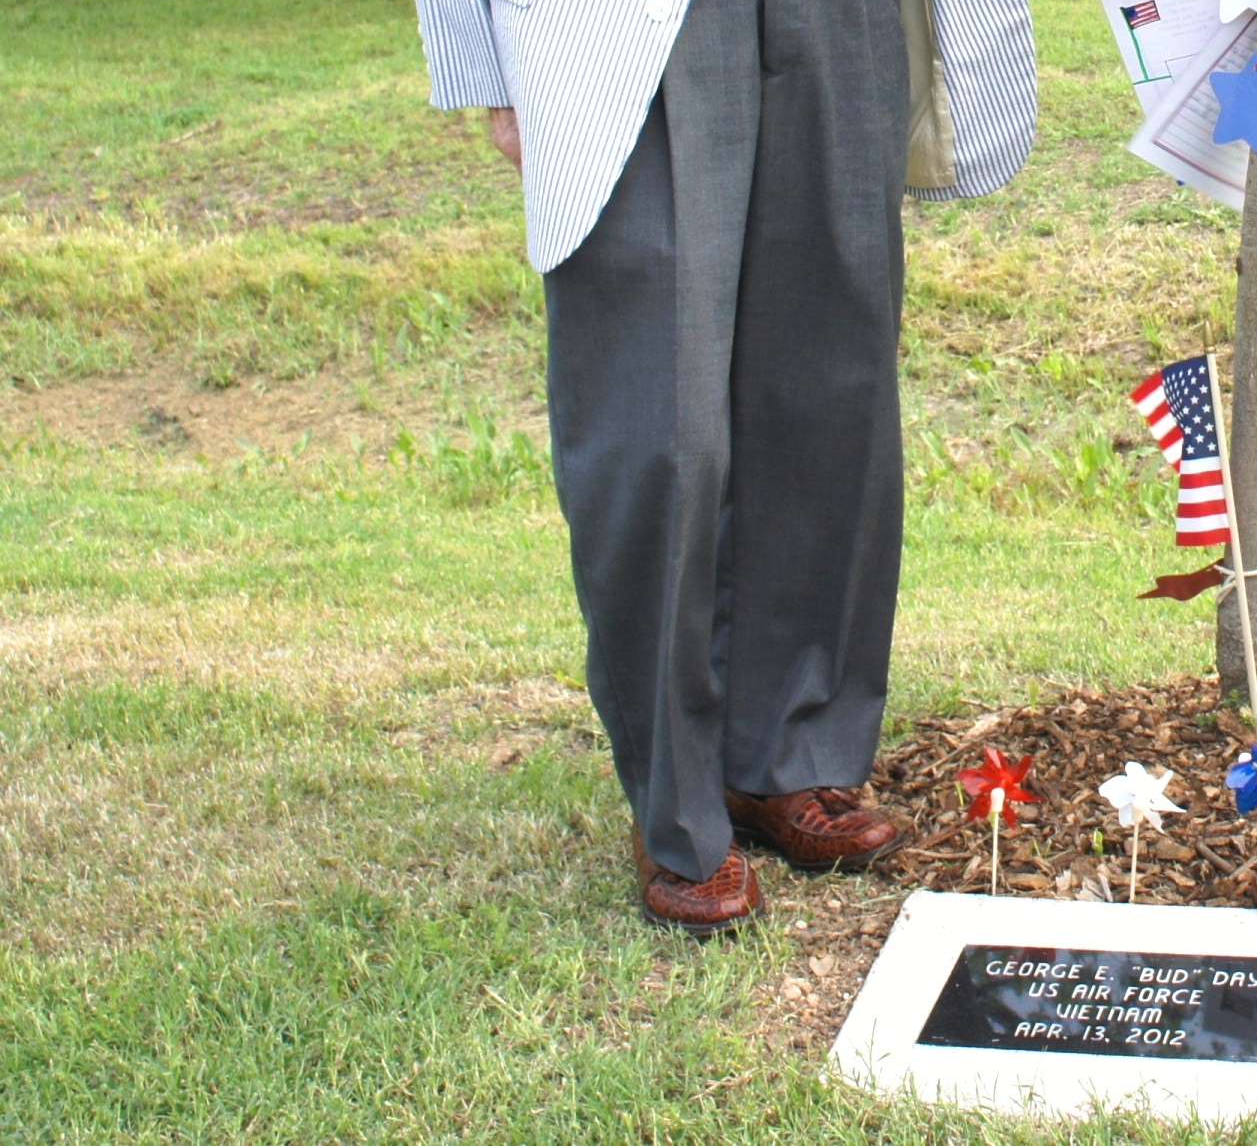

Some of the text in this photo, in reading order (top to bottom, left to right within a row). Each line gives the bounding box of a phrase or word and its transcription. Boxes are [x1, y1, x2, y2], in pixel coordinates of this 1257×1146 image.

[986, 960, 1081, 980] GEORGE
[1095, 965, 1115, 981] E.
[1132, 966, 1202, 984] "BUD"
[1028, 982, 1204, 1005] US AIR FORCE
[1056, 1003, 1162, 1024] VIETNAM
[1014, 1021, 1068, 1040] APR.
[1125, 1028, 1186, 1046] 2012
